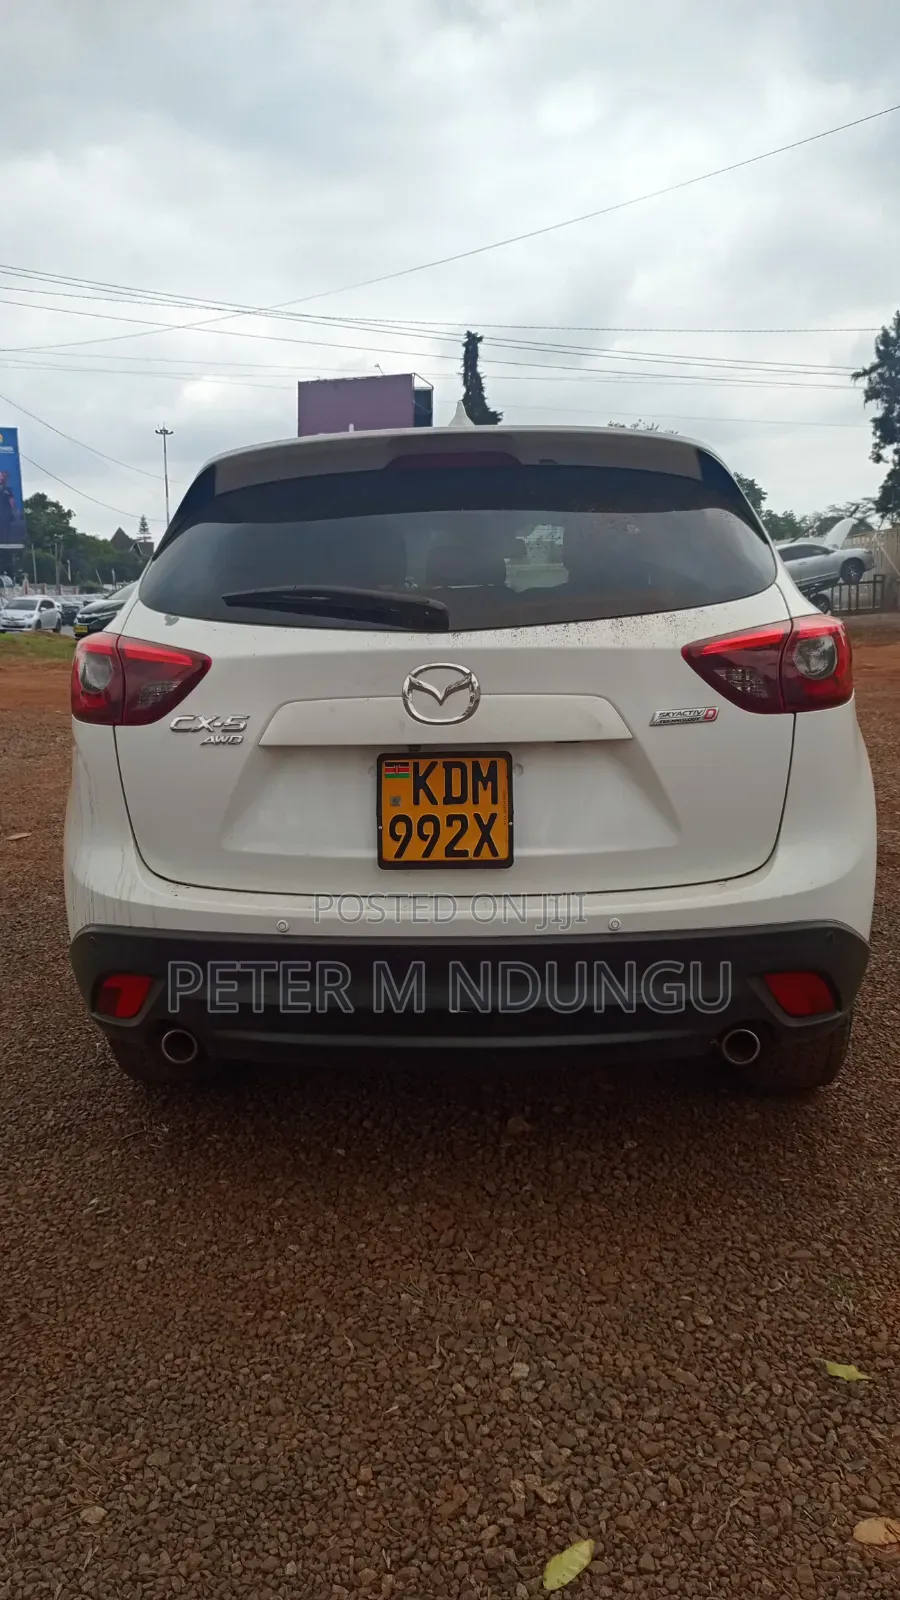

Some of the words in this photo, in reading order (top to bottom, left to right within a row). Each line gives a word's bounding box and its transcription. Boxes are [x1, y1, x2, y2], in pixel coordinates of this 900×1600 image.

[659, 709, 704, 718] SKYACTIV
[170, 715, 250, 732] CX-5
[200, 735, 244, 746] AWD
[413, 760, 498, 805] KDM
[389, 813, 499, 858] 992X
